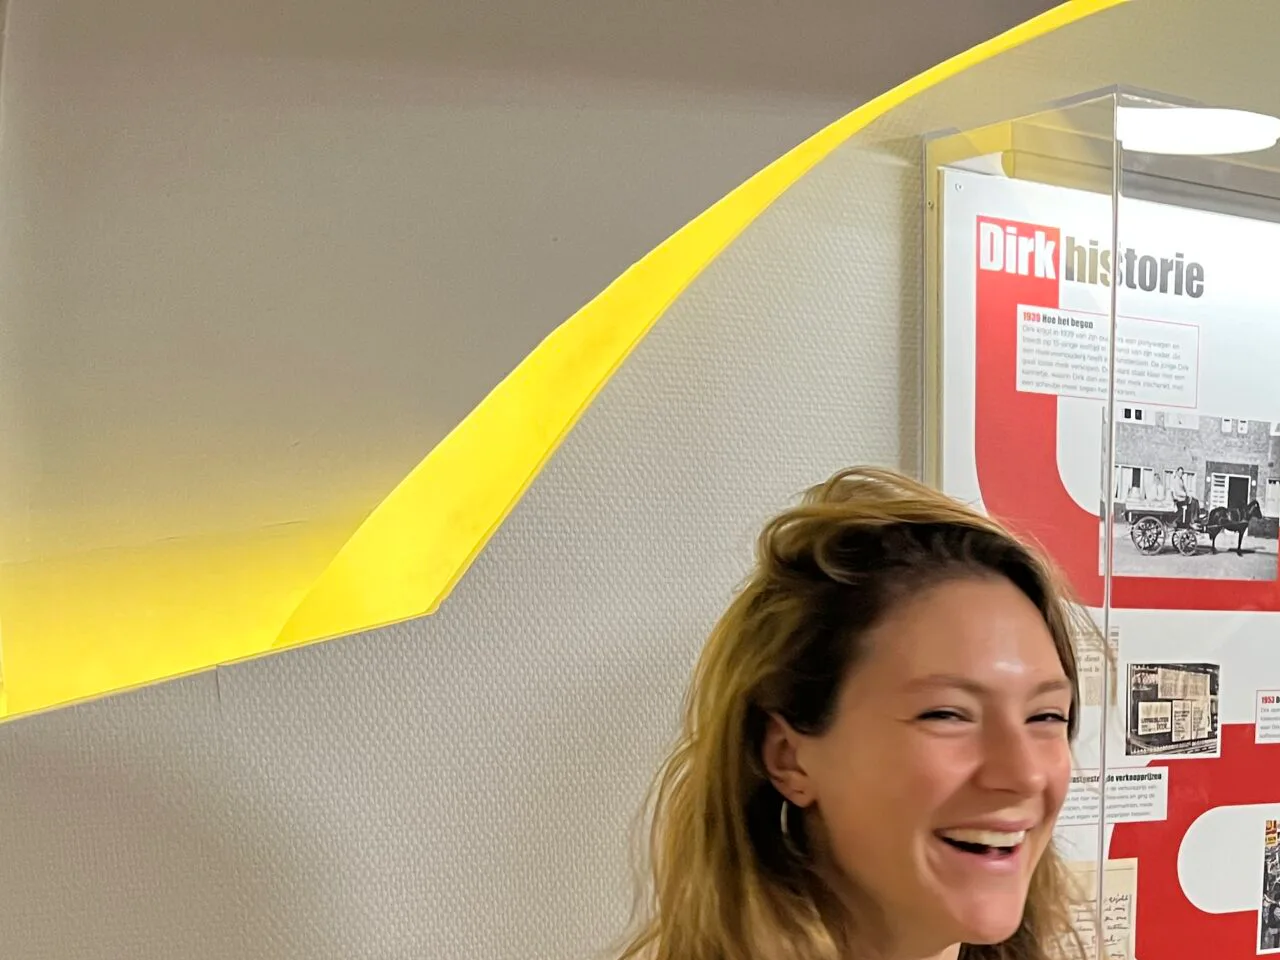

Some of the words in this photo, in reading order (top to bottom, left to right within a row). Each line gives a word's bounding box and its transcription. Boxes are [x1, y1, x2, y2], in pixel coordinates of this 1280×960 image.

[979, 221, 1056, 280] Dirk
[1065, 235, 1205, 299] historie
[1042, 315, 1056, 325] Hoe
[1057, 316, 1070, 327] het
[1070, 319, 1093, 330] begon
